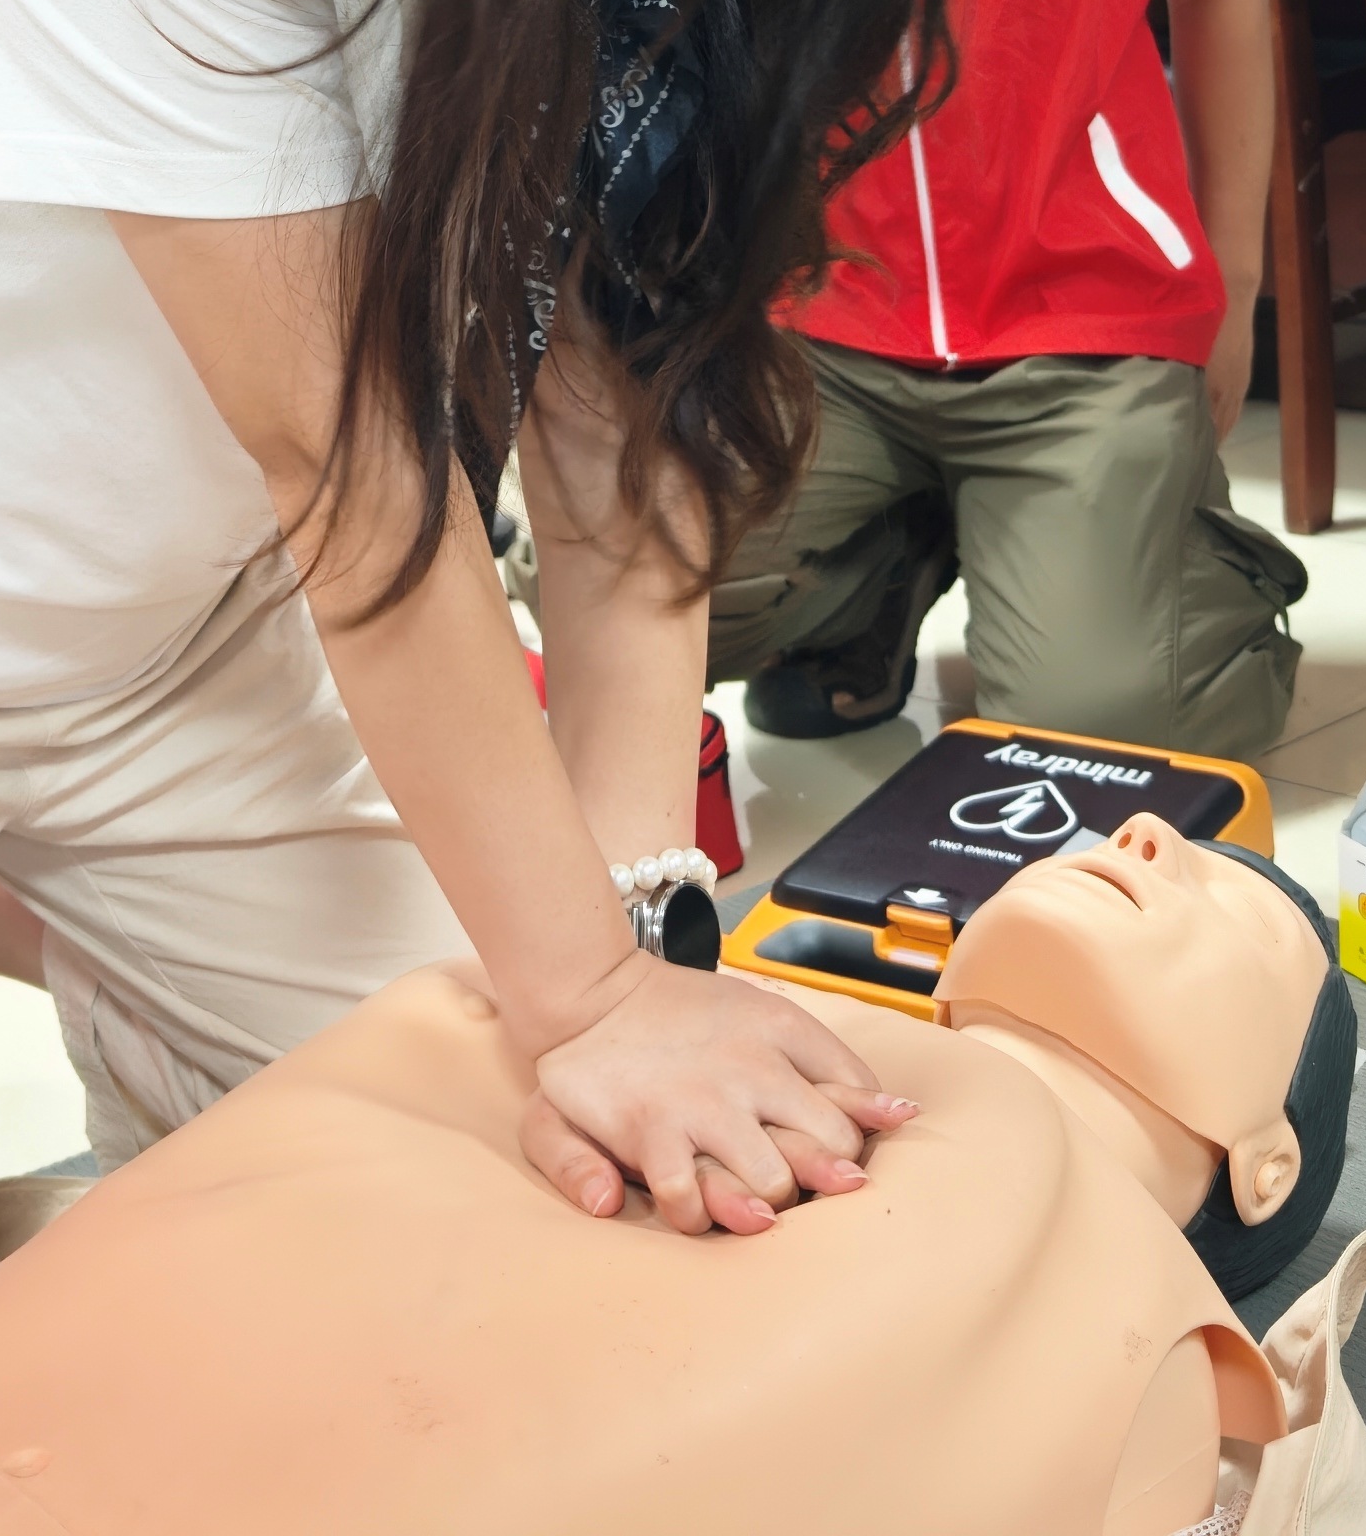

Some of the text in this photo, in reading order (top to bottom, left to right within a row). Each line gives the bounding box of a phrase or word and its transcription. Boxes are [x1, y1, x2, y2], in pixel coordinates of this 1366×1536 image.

[984, 743, 1153, 785] mindray
[928, 838, 1023, 864] TRAINING ONLY
